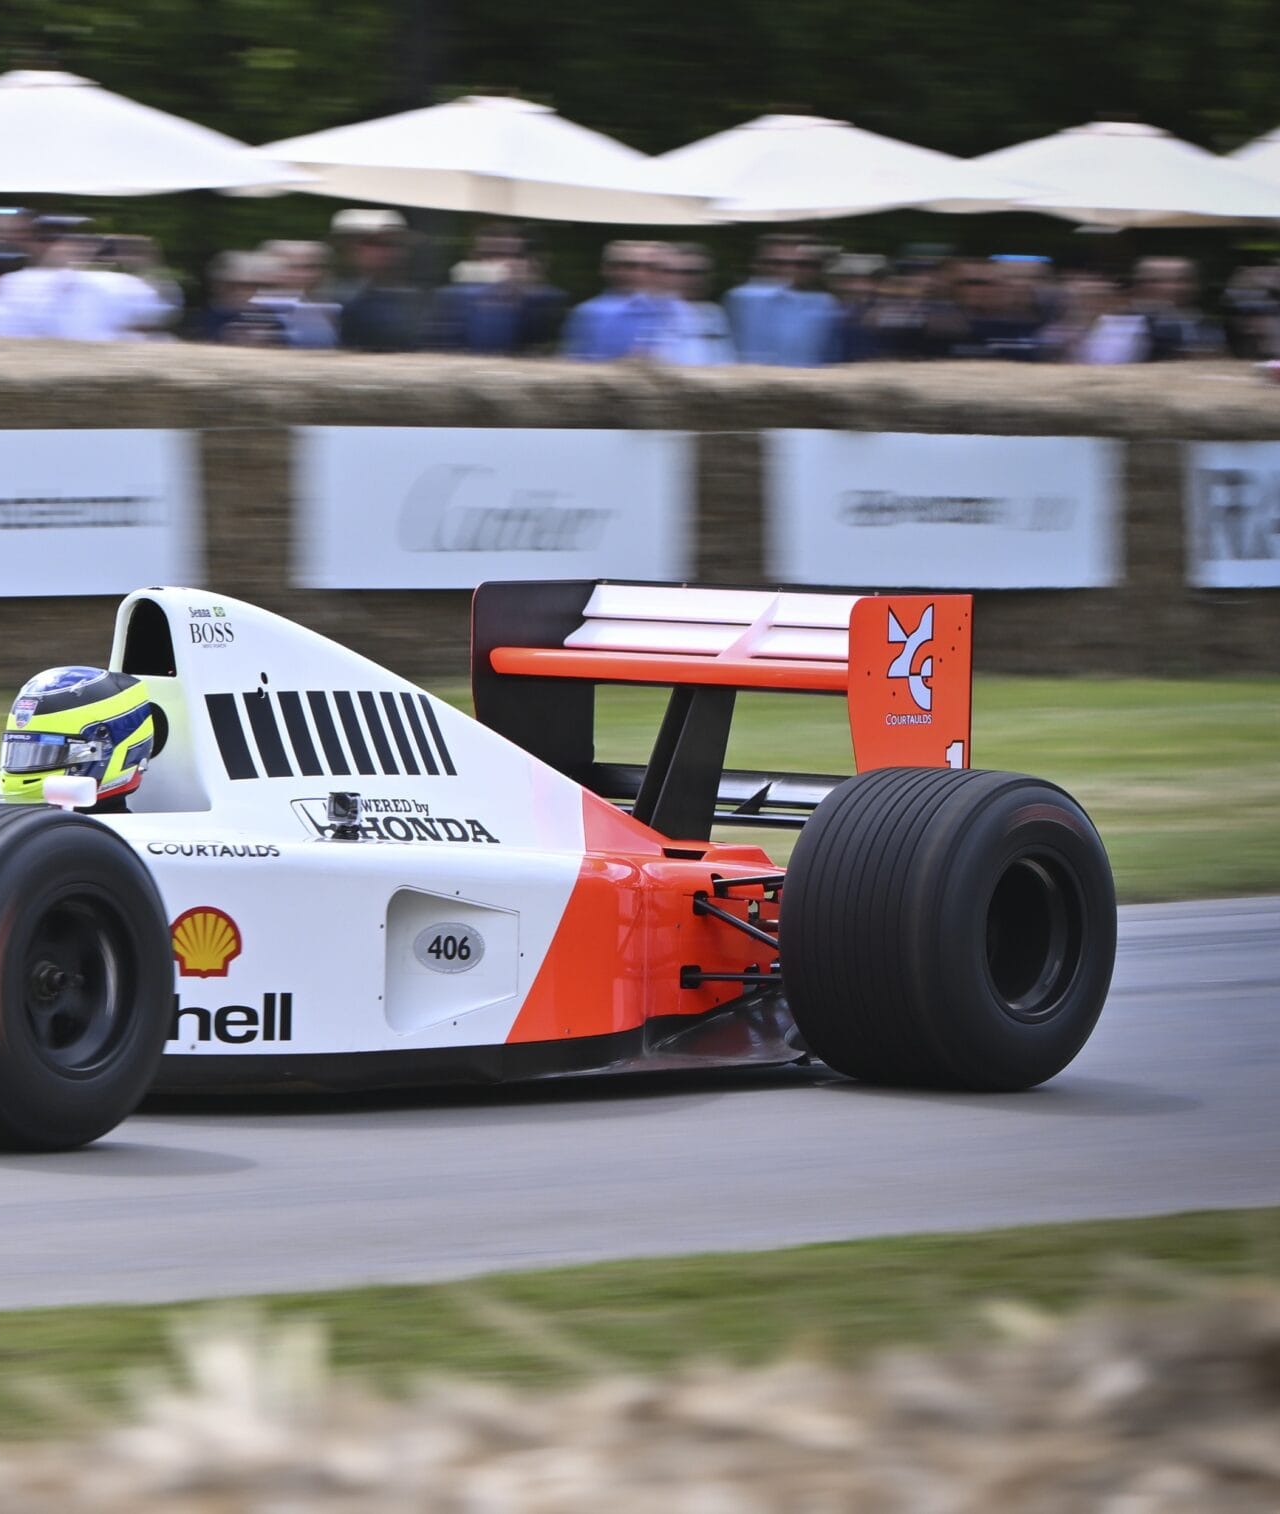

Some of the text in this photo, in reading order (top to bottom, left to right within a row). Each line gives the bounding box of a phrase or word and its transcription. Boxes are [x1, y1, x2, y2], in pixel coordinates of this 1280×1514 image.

[189, 622, 234, 643] BOSS
[945, 740, 964, 769] 1
[360, 799, 430, 817] WERED by
[358, 815, 501, 844] HONDA
[427, 934, 471, 961] 406
[165, 992, 293, 1044] hell
